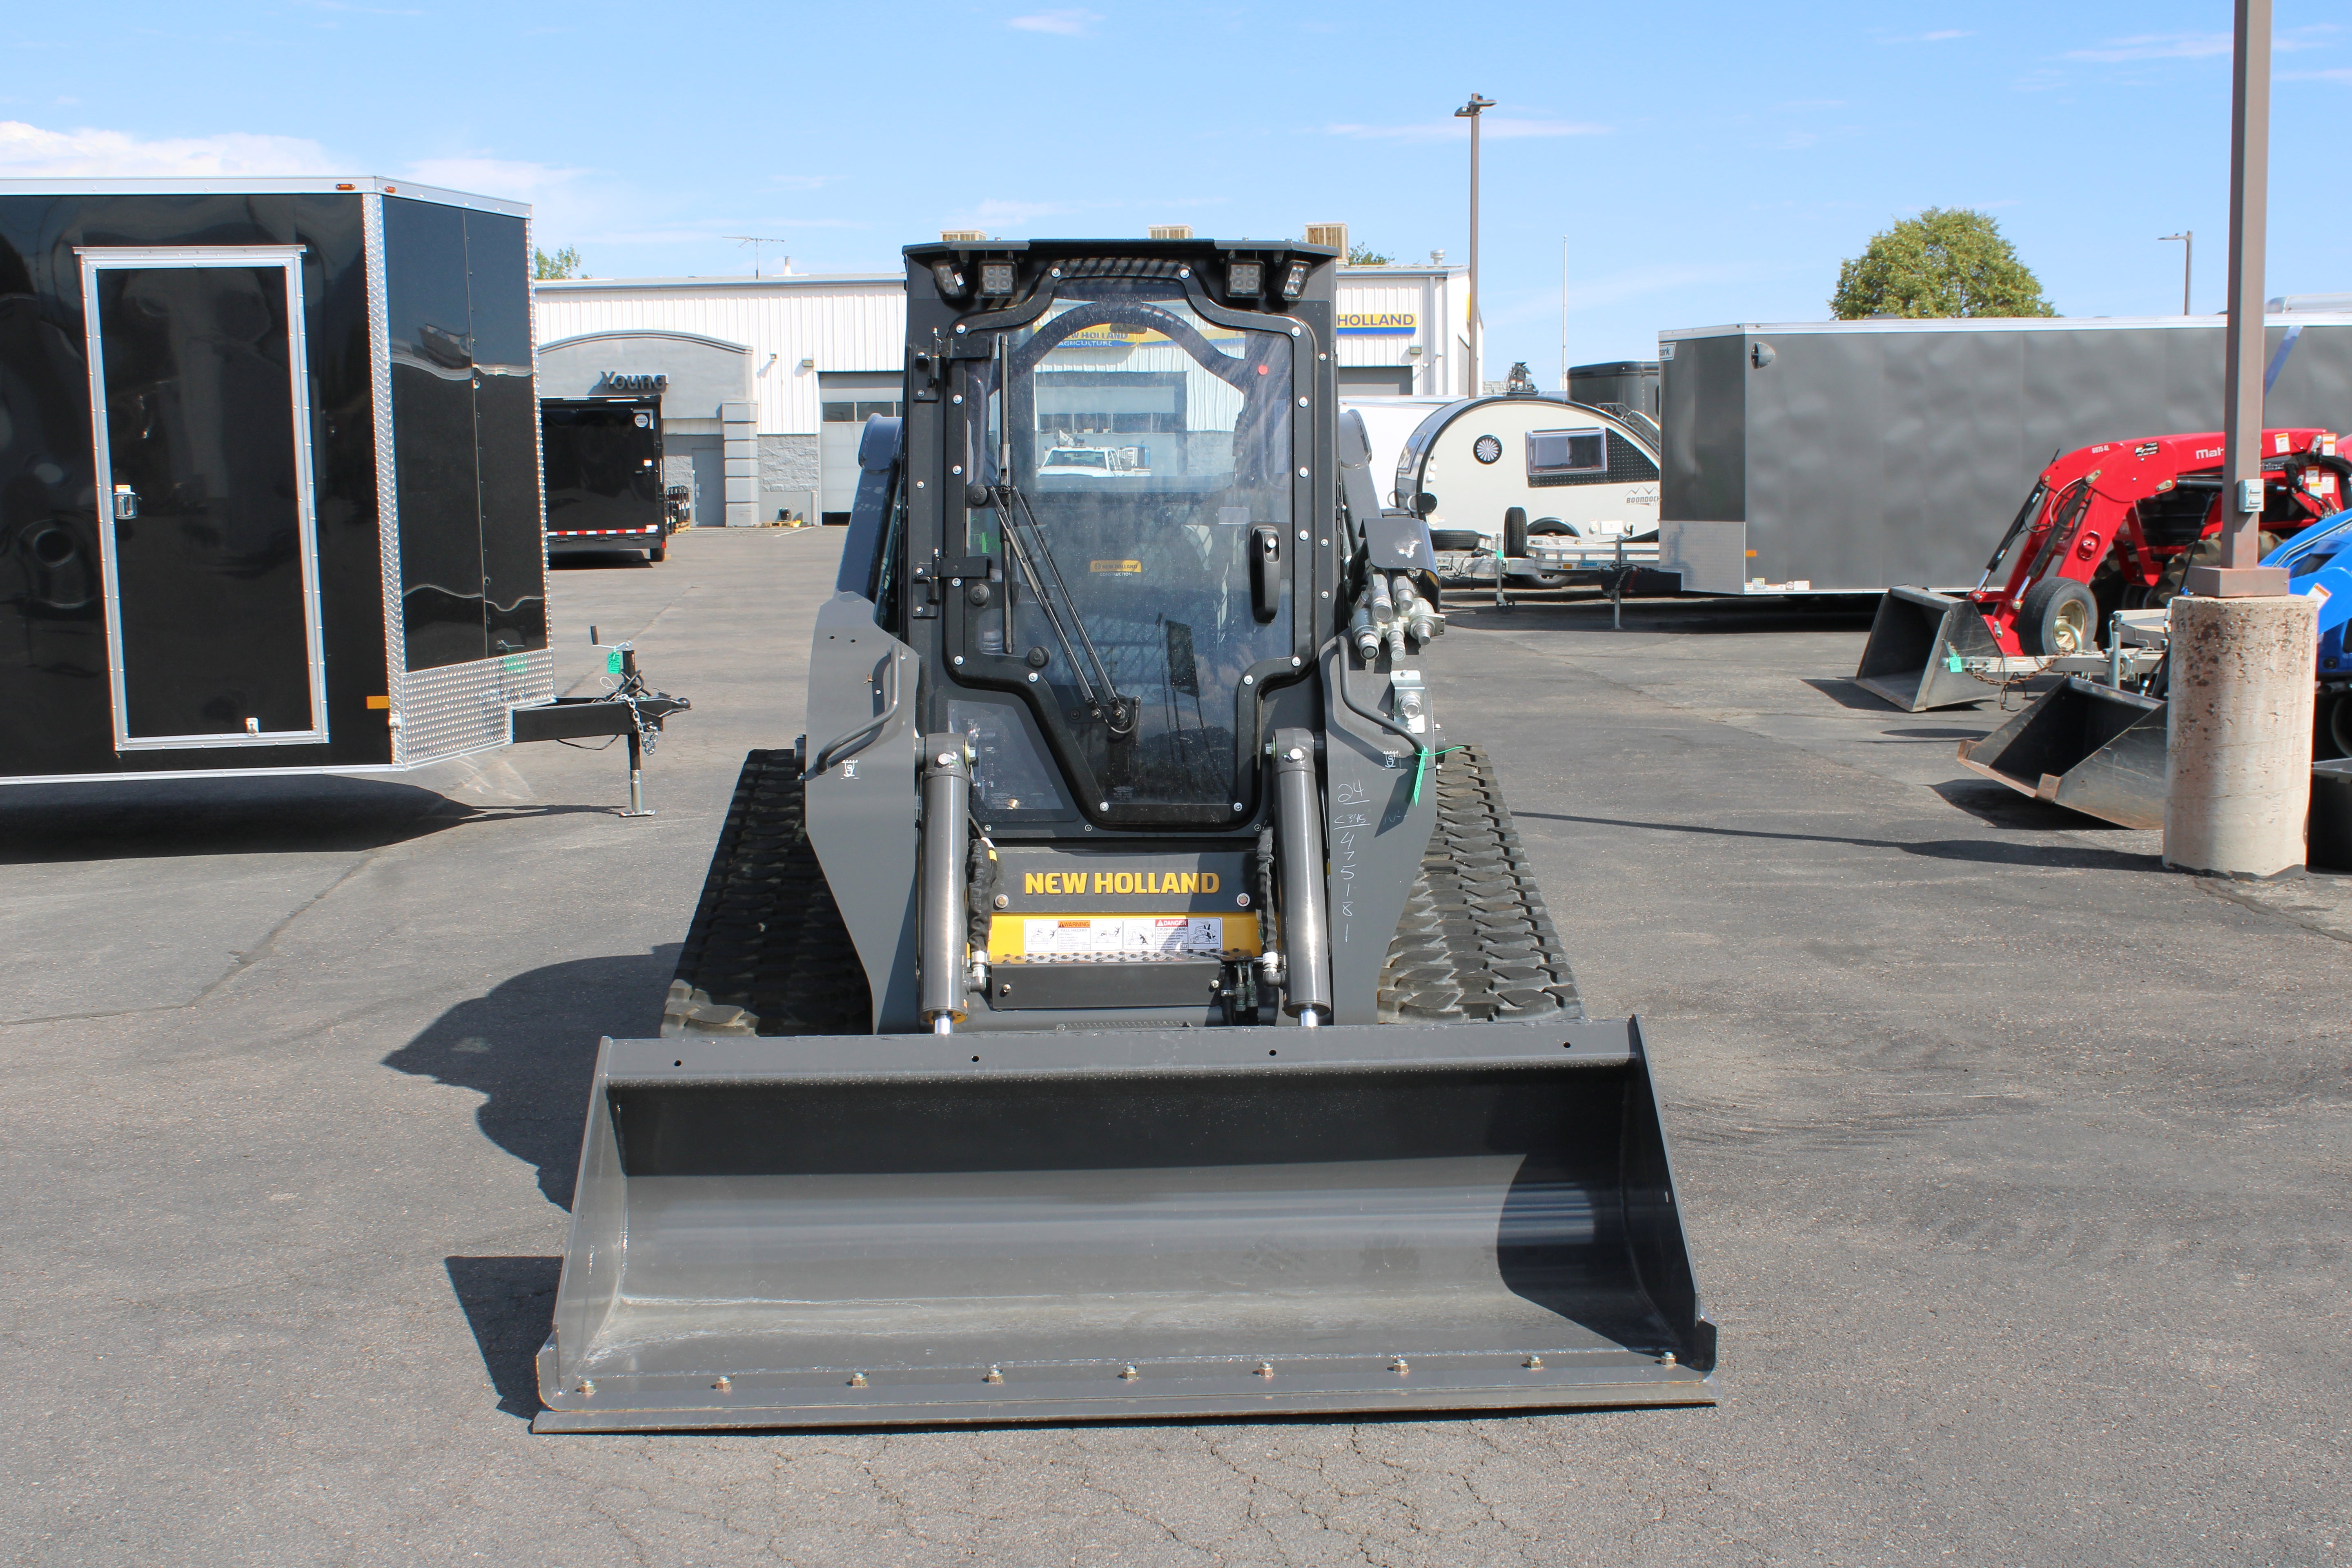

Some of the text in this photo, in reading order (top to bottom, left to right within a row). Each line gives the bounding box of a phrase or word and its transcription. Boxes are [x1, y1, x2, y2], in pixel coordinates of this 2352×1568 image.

[1337, 314, 1414, 326] HOLLAND
[600, 371, 667, 394] Young
[1337, 779, 1365, 802] 24
[1025, 872, 1220, 894] NEW HOLLAND
